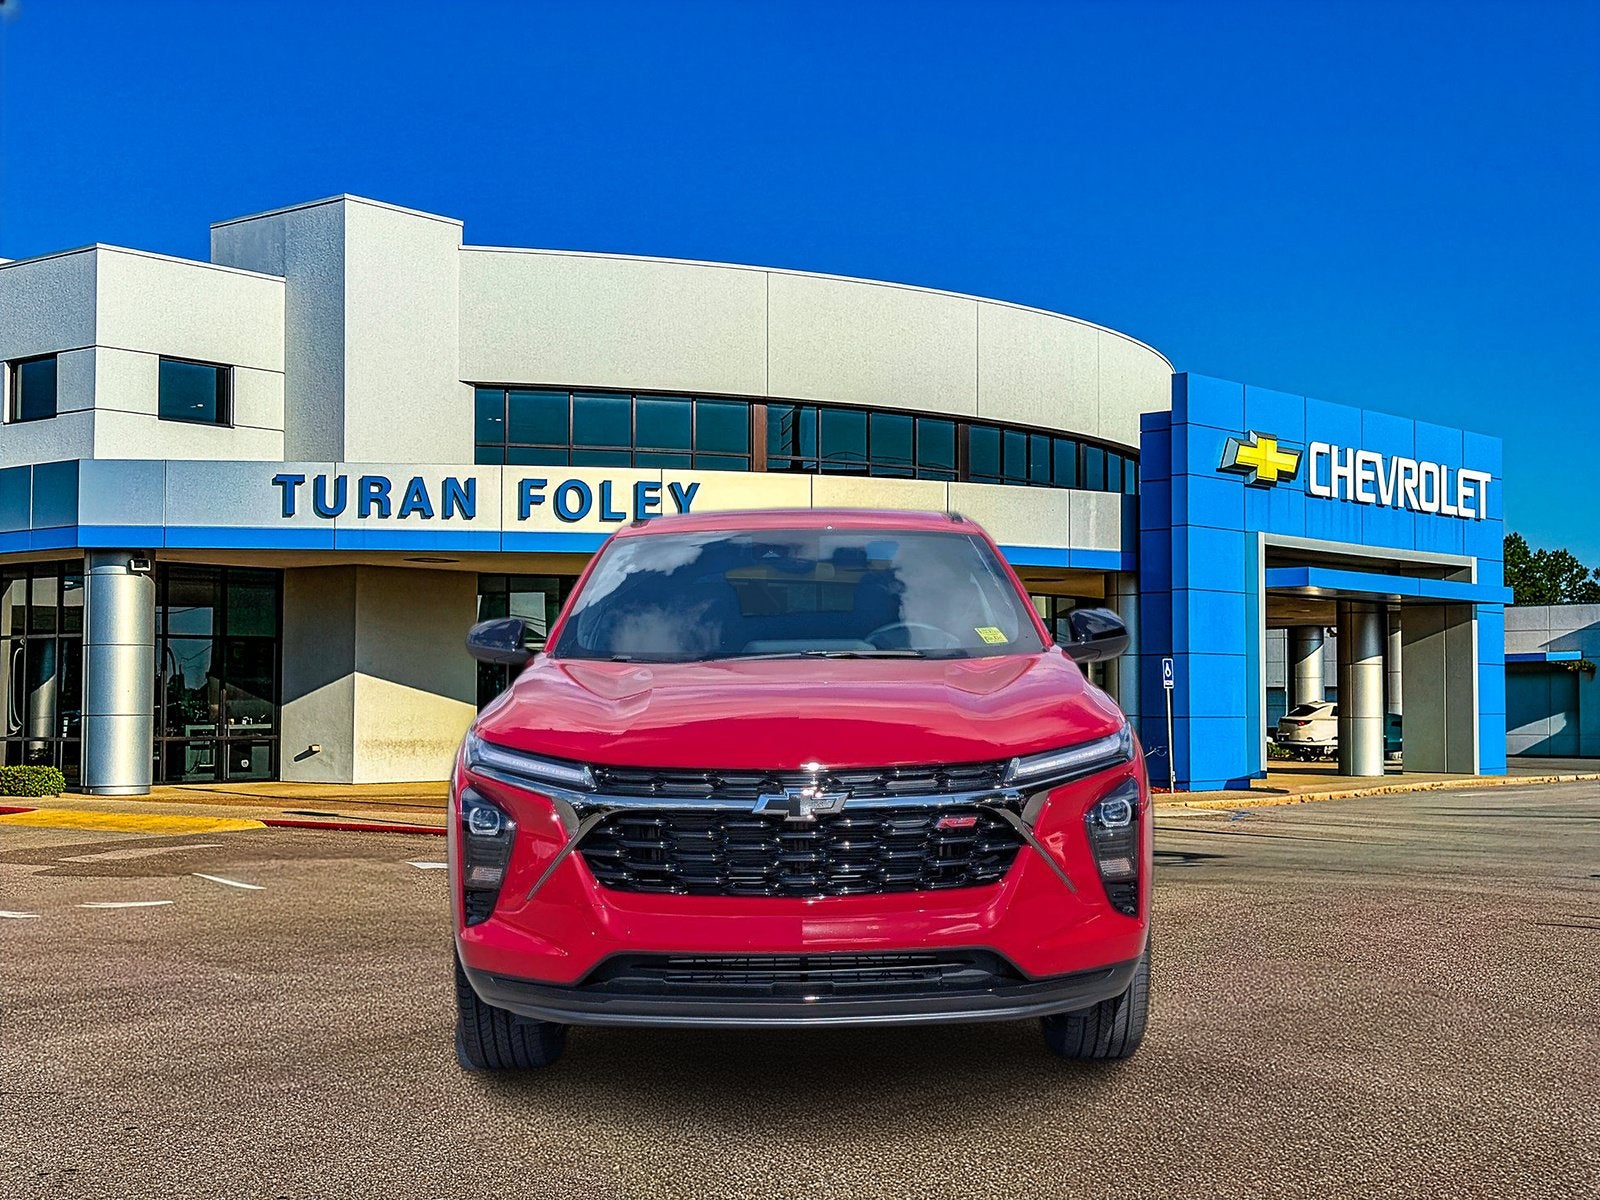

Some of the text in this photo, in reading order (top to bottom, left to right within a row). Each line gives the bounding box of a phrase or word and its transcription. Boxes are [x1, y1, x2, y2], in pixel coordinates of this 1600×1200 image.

[271, 474, 701, 523] TURAN FOLEY
[1308, 441, 1492, 520] CHEVROLET
